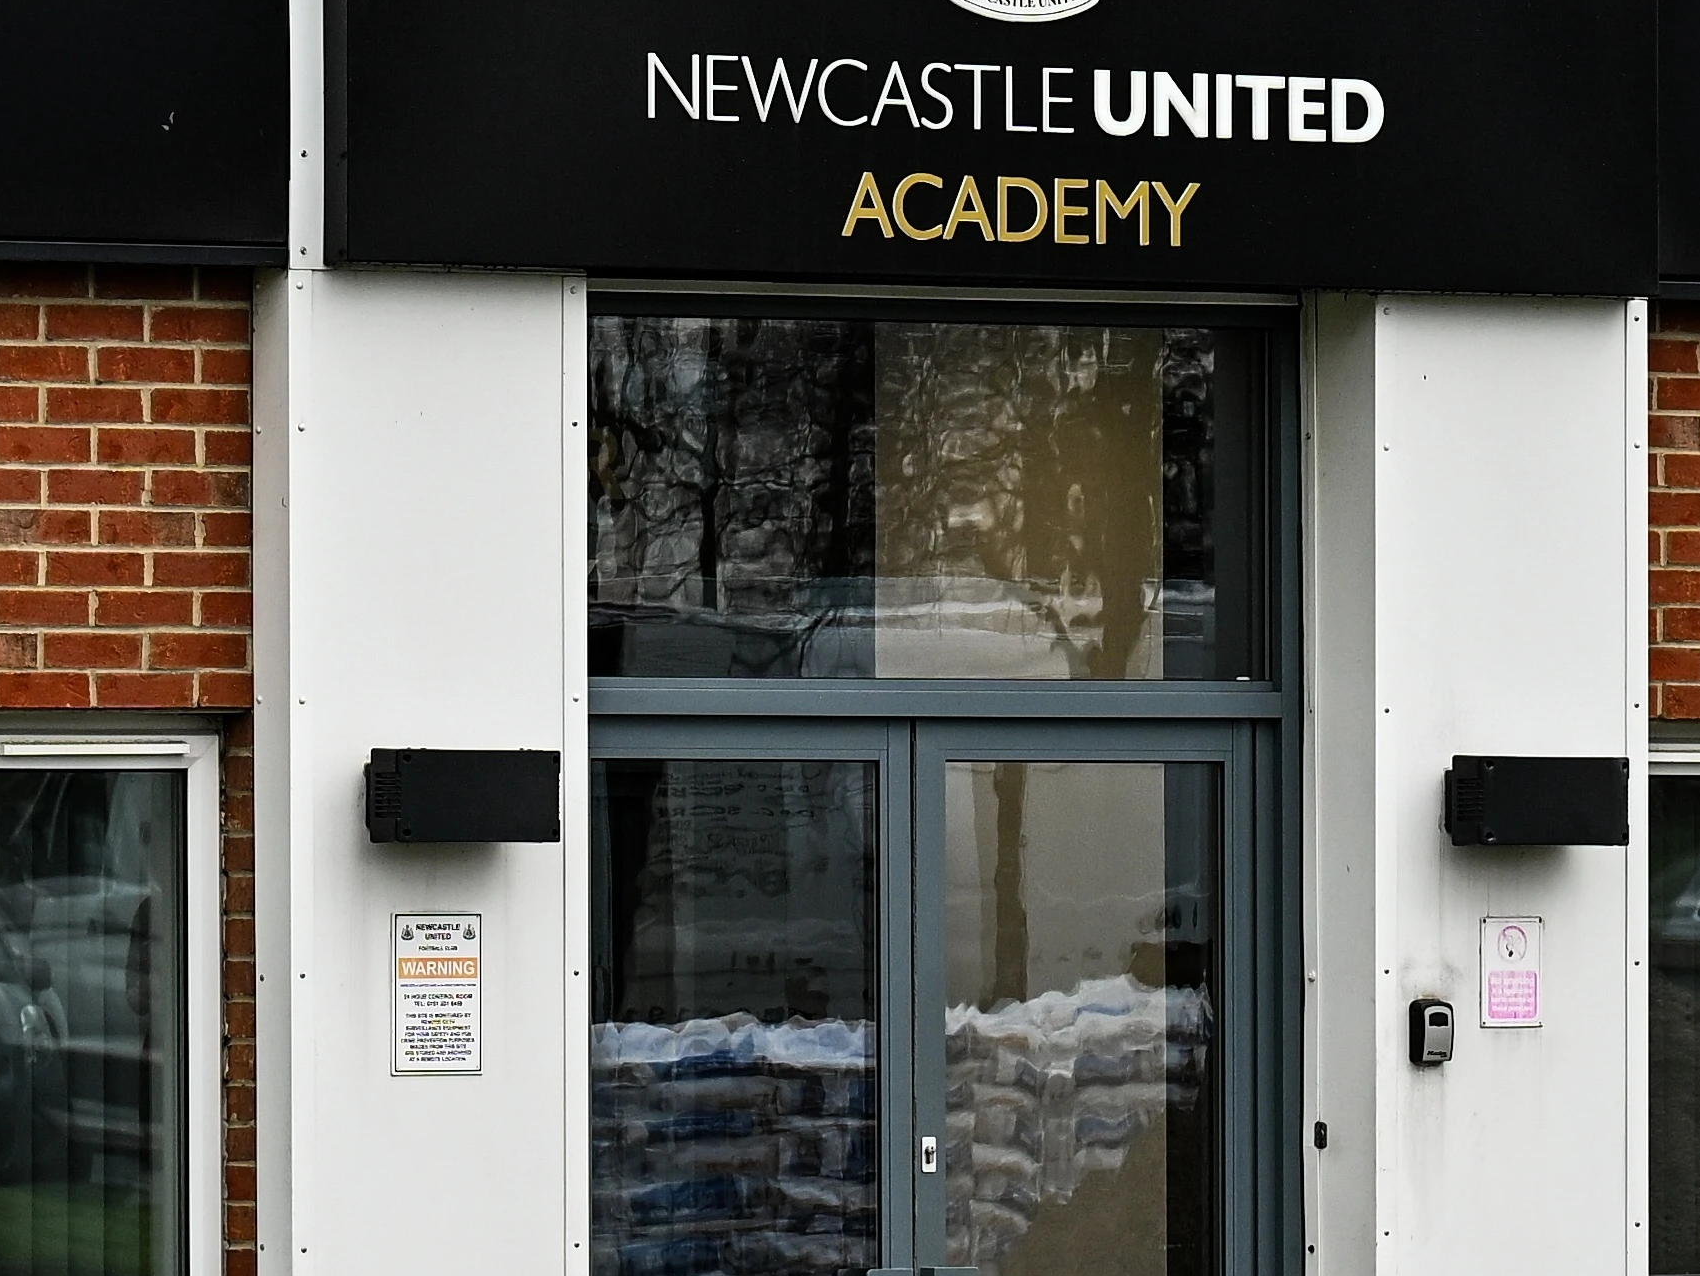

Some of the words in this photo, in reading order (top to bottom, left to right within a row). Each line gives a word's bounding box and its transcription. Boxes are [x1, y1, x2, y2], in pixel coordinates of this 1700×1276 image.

[646, 51, 1075, 135] NEWCASTLE
[1093, 69, 1386, 144] UNITED
[841, 170, 1201, 248] ACADEMY
[415, 923, 461, 931] NEWCASTLE
[424, 932, 452, 941] UNITED
[401, 960, 475, 976] WARNING
